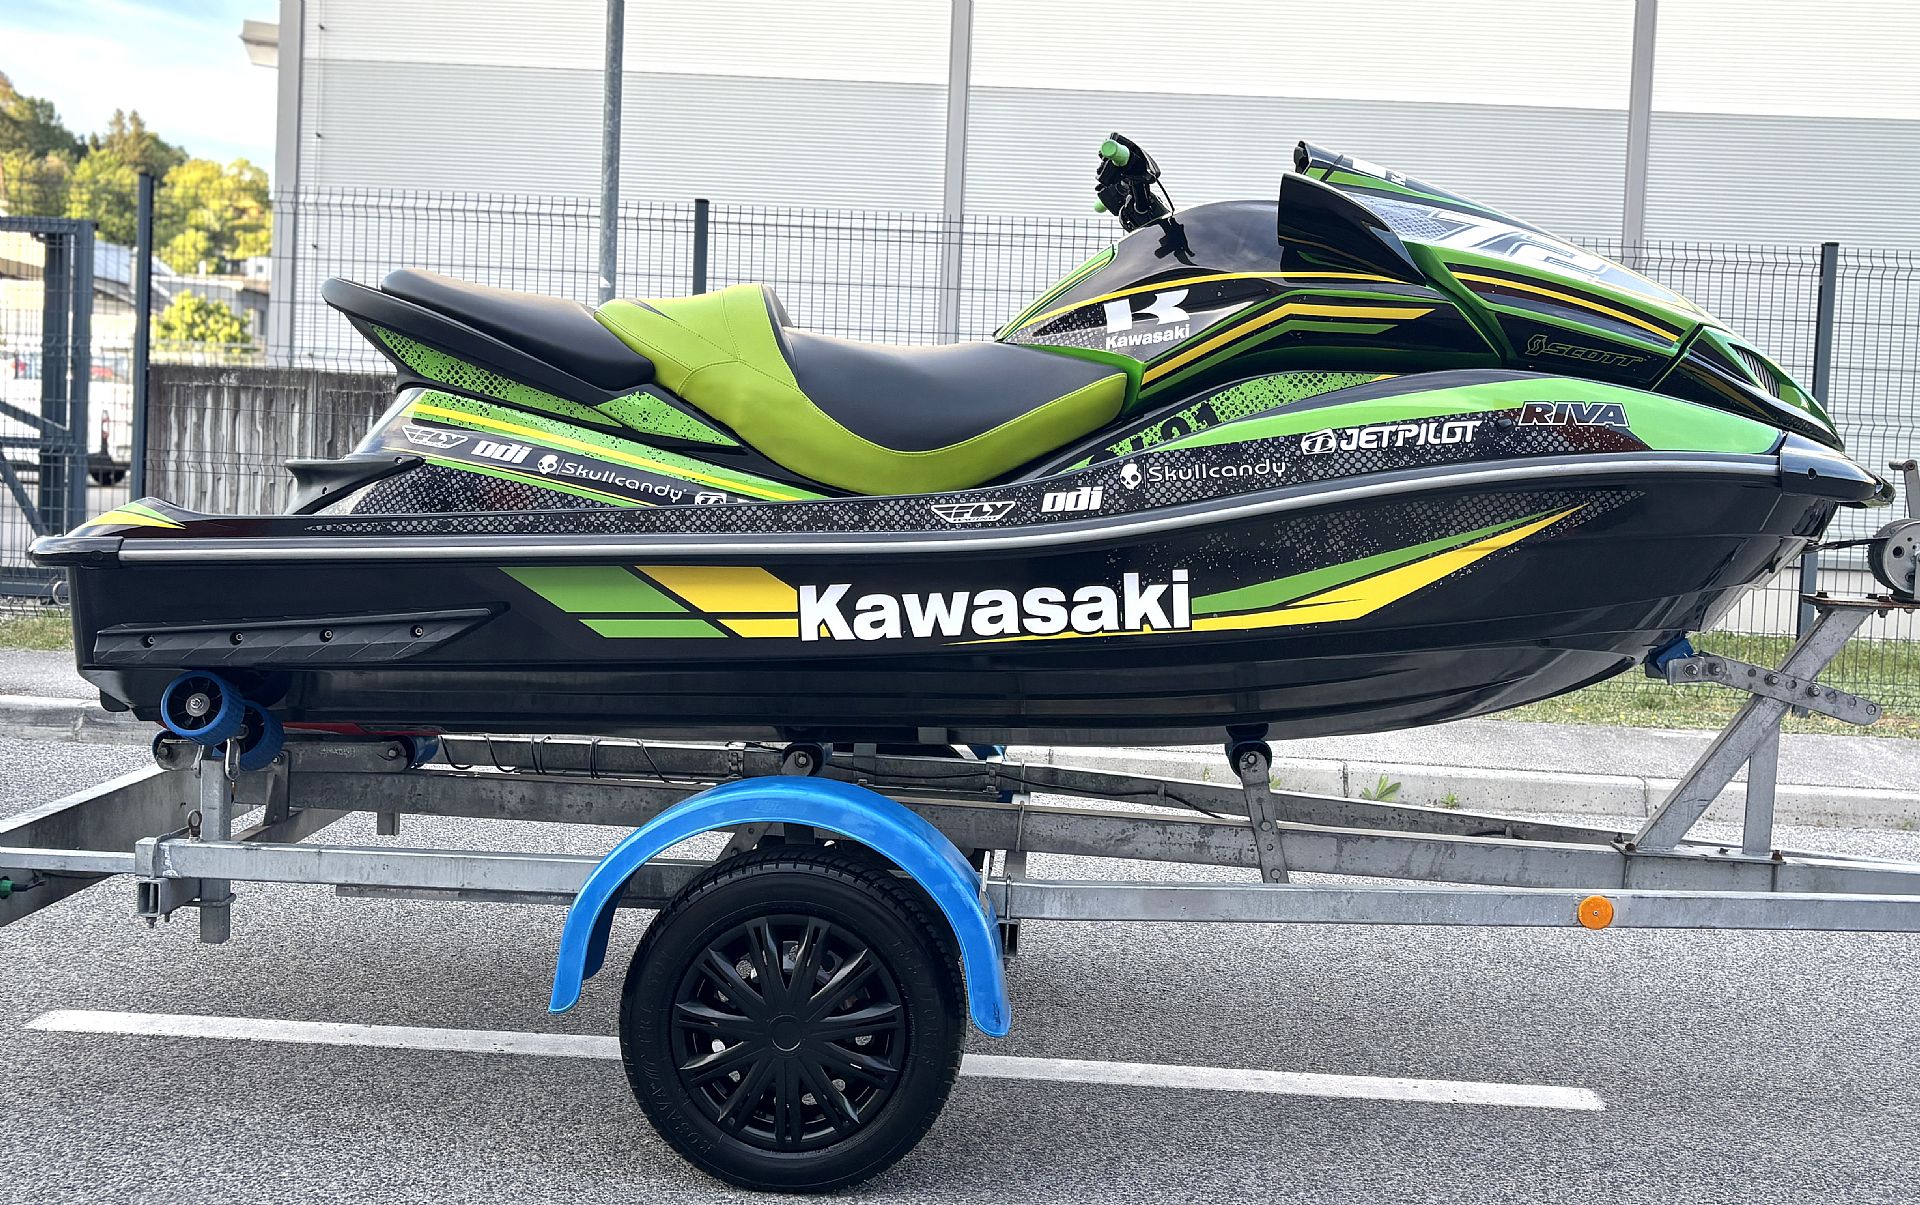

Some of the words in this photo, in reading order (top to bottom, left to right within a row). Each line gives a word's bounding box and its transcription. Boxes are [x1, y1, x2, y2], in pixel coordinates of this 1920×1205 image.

[1105, 323, 1190, 350] Kawasaki
[1545, 342, 1641, 367] SCOTT
[1518, 402, 1630, 427] RIVA
[1339, 420, 1483, 451] JETPILOT
[561, 462, 684, 503] Skullcandy
[1148, 458, 1287, 483] Skullcandy
[800, 569, 1191, 642] Kawasaki
